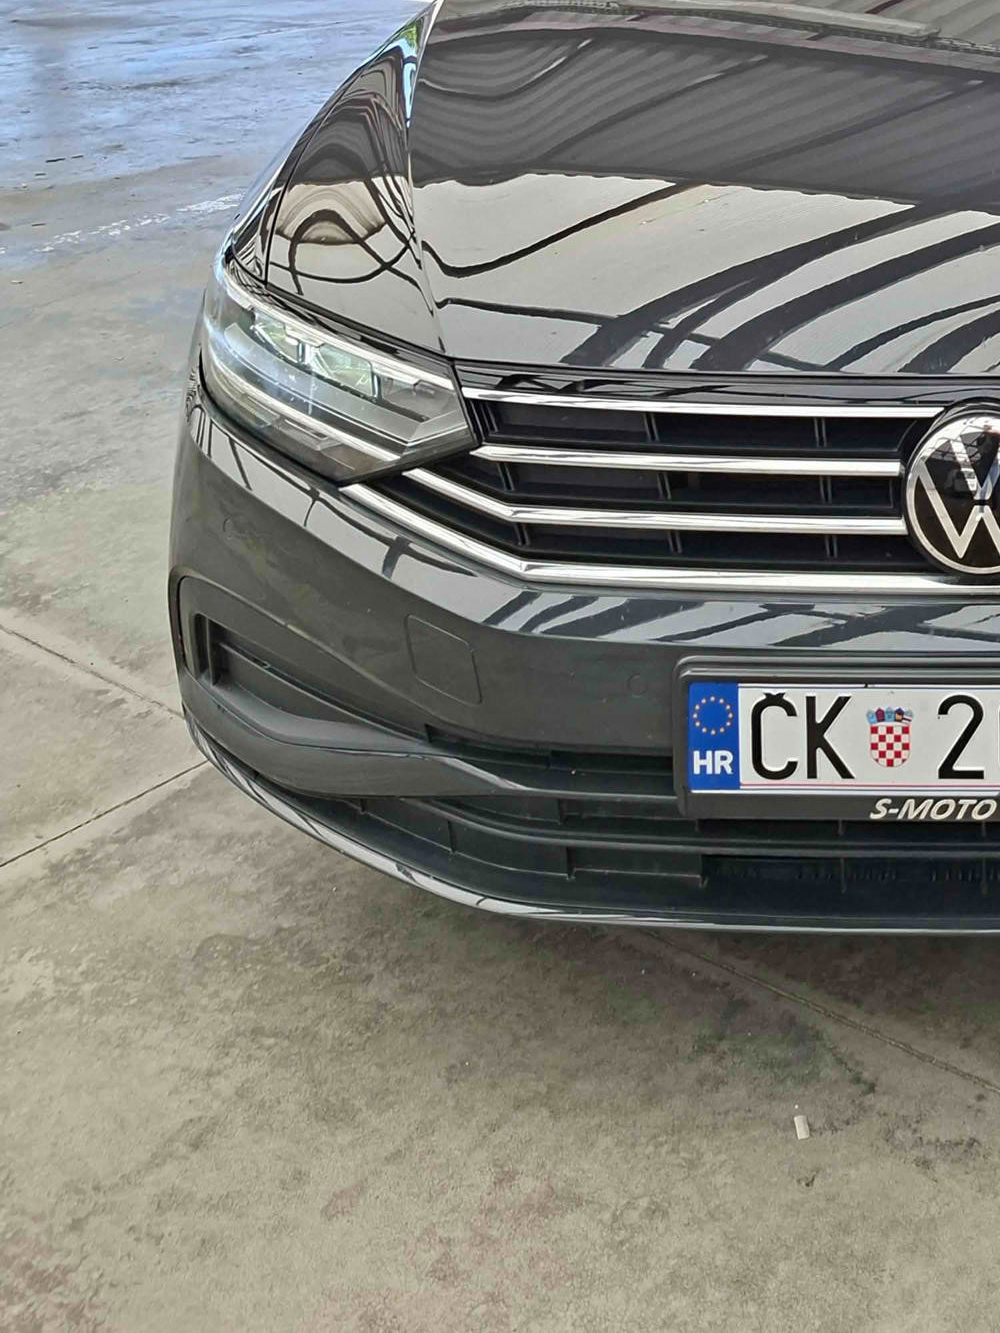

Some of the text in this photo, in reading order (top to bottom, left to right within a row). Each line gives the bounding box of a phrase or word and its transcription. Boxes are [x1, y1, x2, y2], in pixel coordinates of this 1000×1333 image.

[750, 692, 855, 781] ČK
[692, 749, 734, 775] HR
[869, 798, 998, 821] S-MOTO
